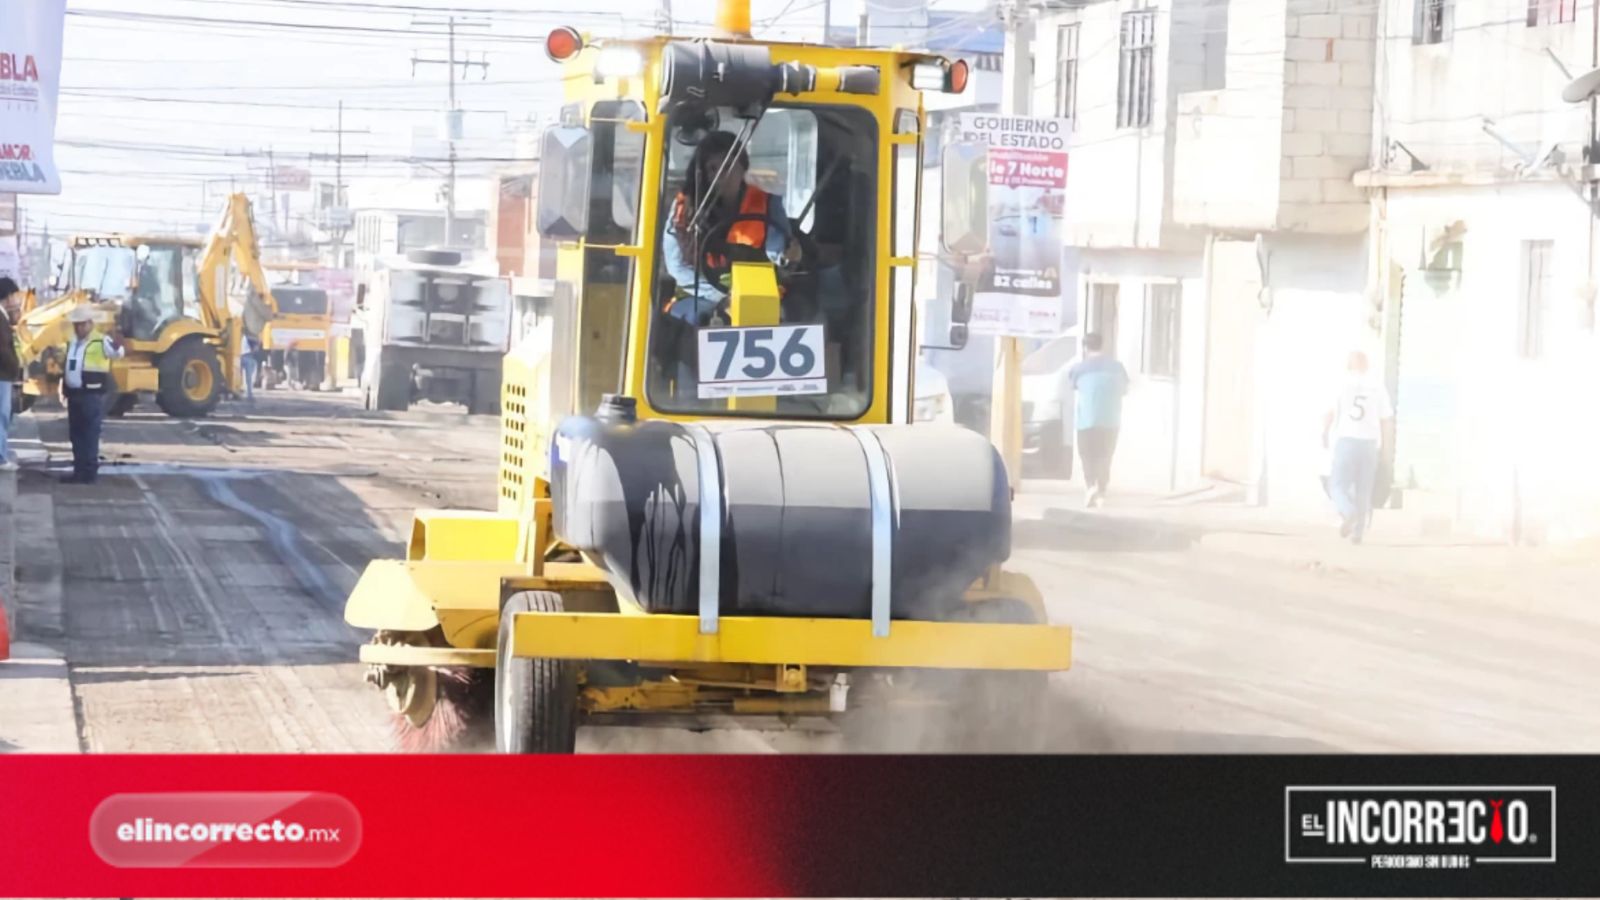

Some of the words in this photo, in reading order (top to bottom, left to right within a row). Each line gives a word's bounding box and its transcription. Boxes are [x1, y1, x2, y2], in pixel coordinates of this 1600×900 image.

[973, 116, 1059, 134] GOBIERNO
[1001, 133, 1063, 150] ESTADO
[1007, 160, 1017, 175] 7
[1020, 162, 1064, 178] Norte
[707, 327, 815, 380] 756
[1348, 394, 1368, 422] 5
